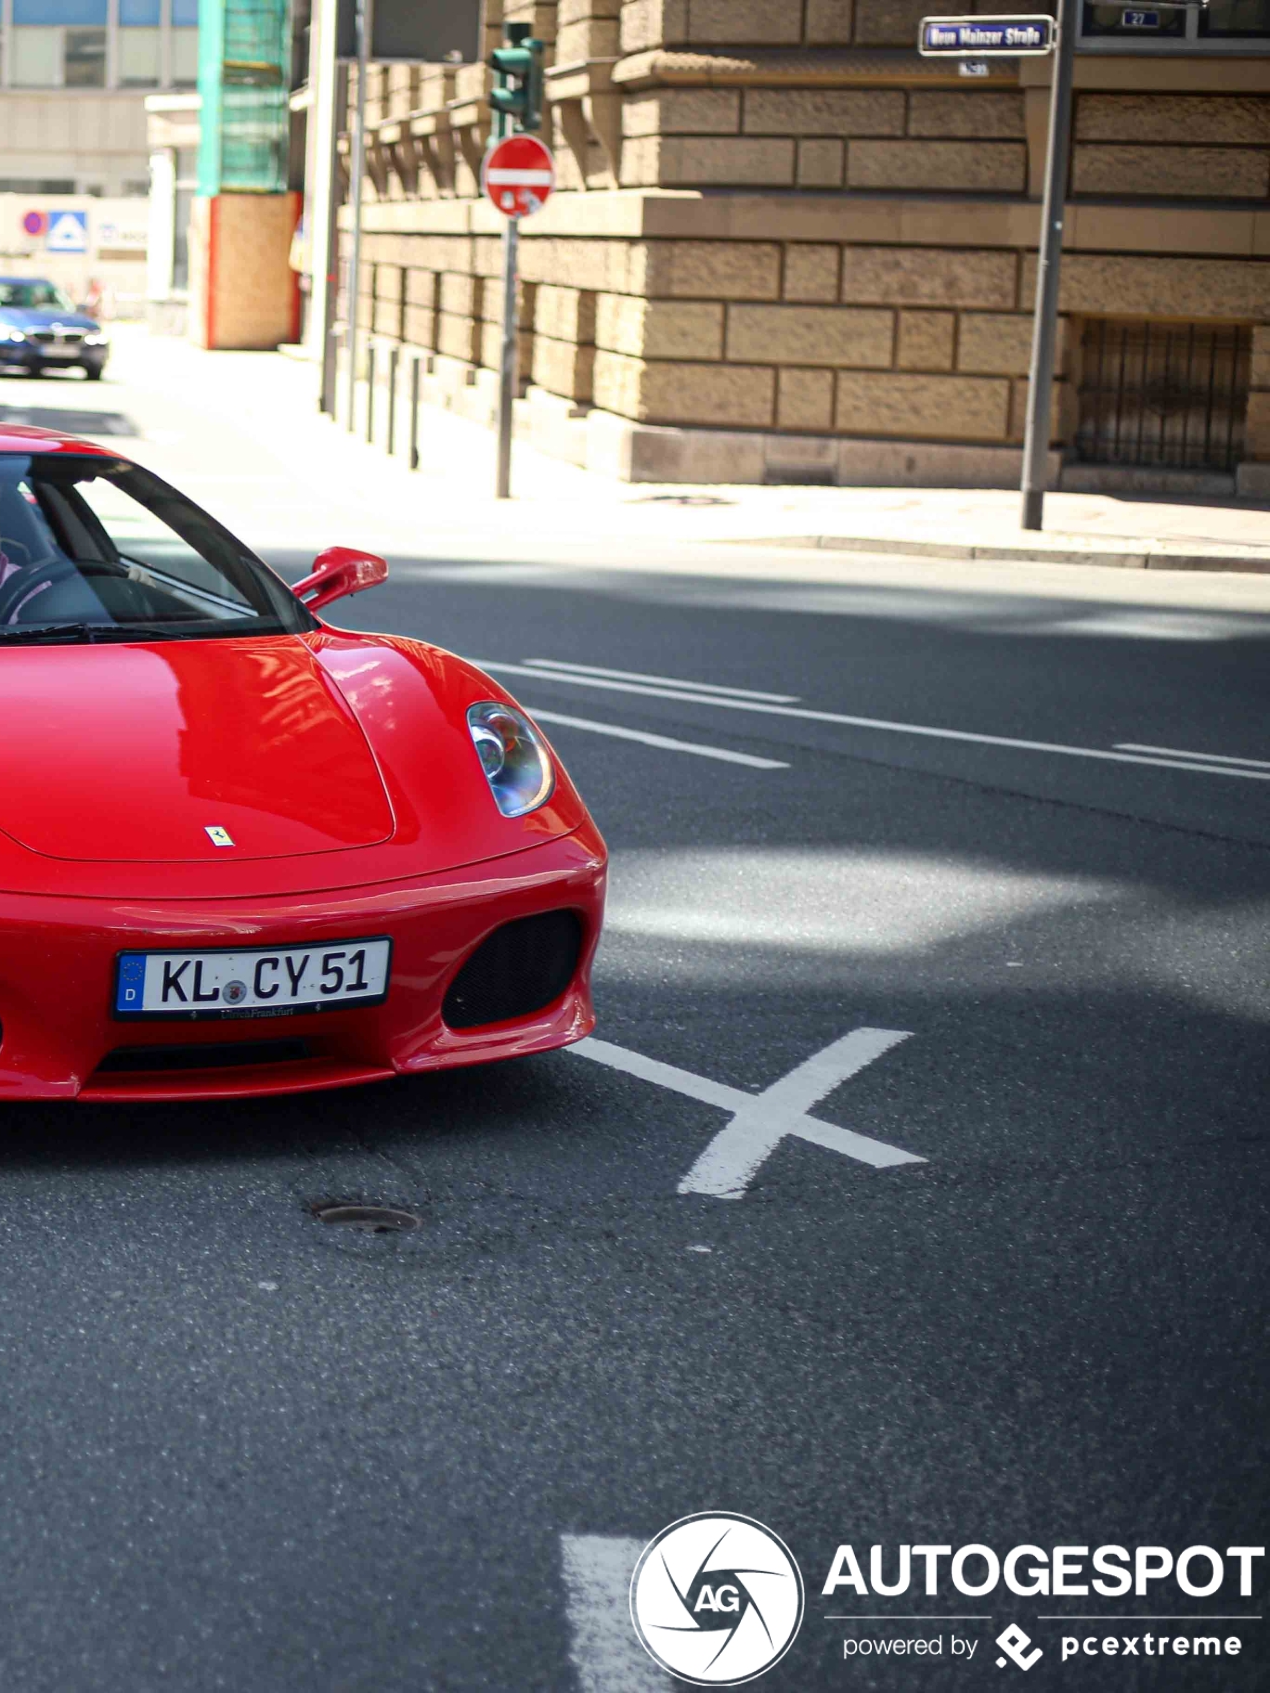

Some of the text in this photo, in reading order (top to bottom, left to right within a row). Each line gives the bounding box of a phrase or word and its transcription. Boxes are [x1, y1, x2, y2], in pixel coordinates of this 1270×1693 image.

[1132, 12, 1145, 25] 27
[959, 26, 1003, 45] Mainzer
[1005, 26, 1040, 46] Straße
[161, 949, 368, 1002] KL CY 51
[125, 988, 136, 1001] D
